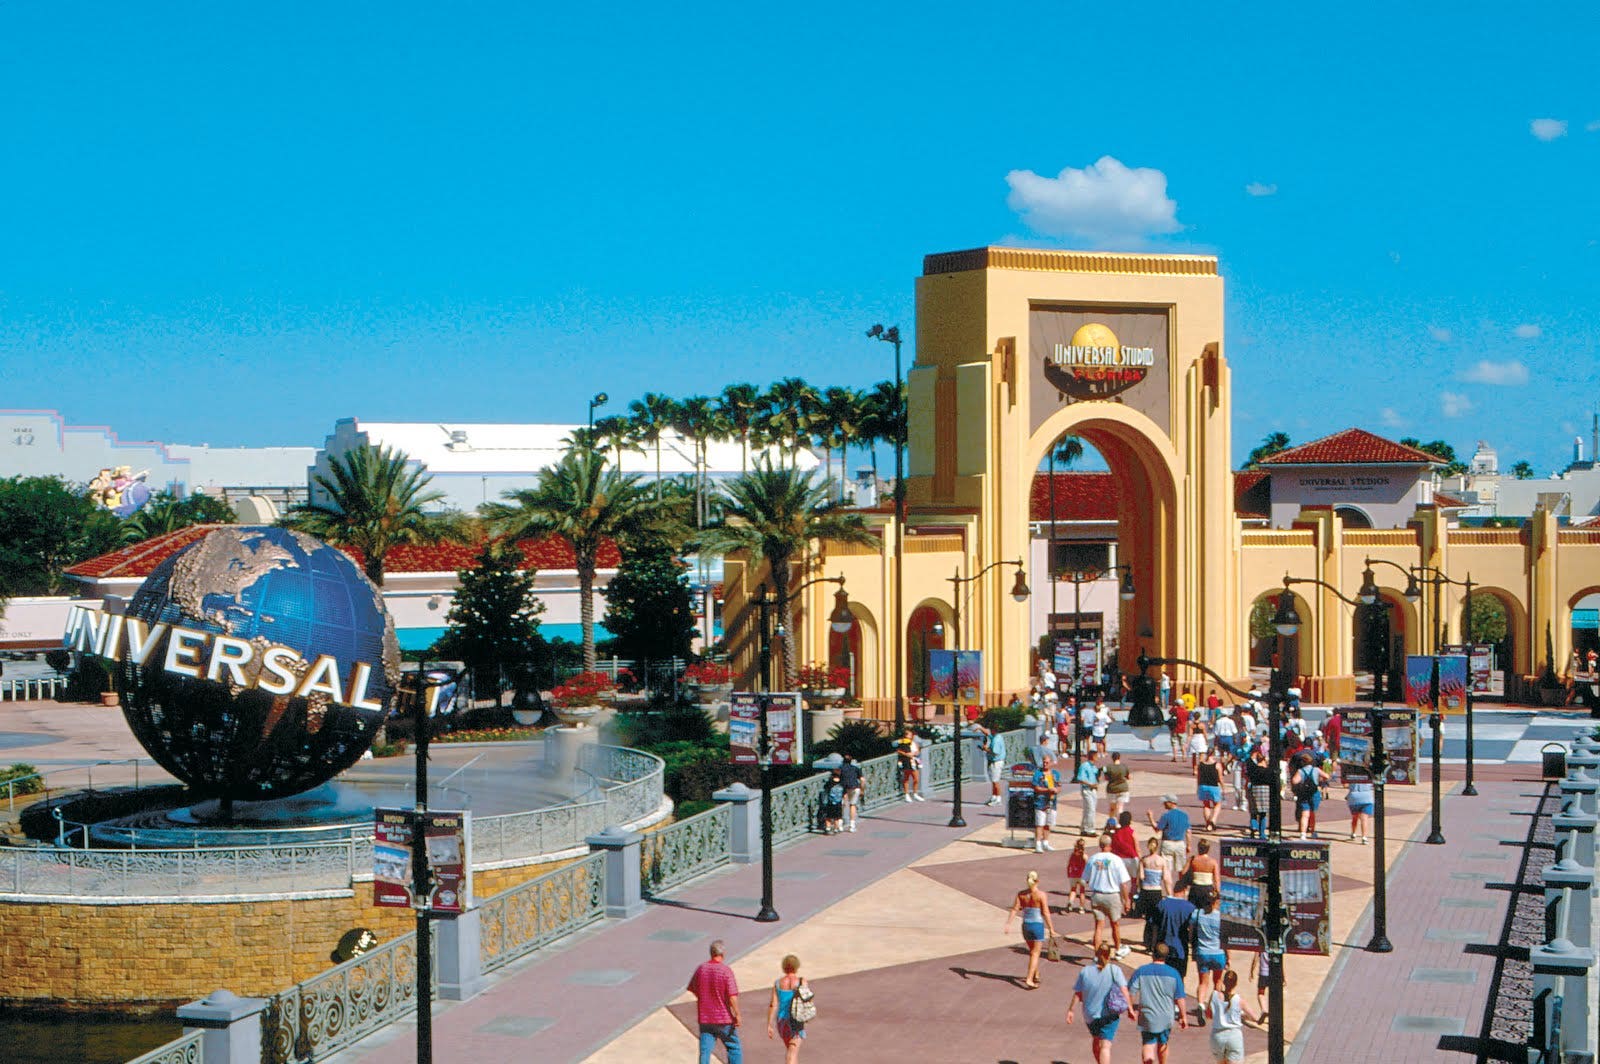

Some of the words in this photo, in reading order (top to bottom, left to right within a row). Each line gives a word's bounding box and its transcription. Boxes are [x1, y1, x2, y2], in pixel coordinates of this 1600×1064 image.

[1054, 344, 1118, 366] UNIVERSAL
[1120, 346, 1154, 366] STUDIOS
[1073, 370, 1141, 381] FLORIDA
[1231, 846, 1257, 856] NOW
[1290, 850, 1320, 859] OPEN
